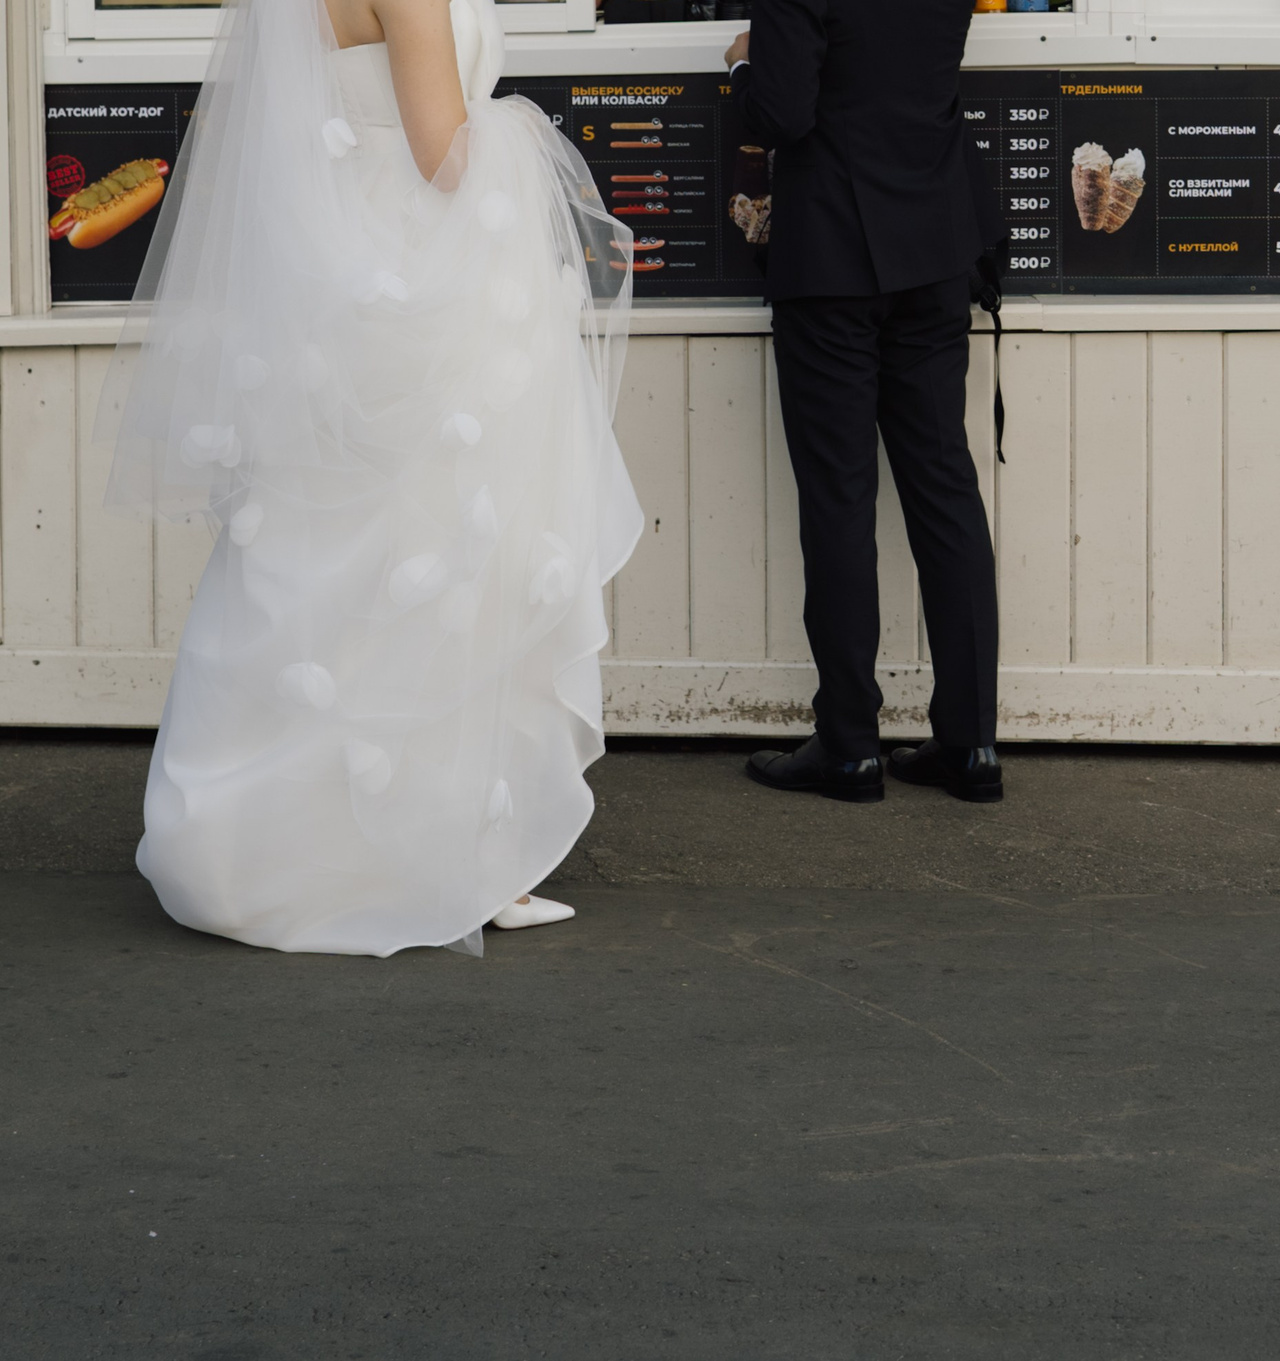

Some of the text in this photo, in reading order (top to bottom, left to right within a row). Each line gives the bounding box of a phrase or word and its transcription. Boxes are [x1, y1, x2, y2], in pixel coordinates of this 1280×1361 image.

[572, 86, 684, 96] ВЫБЕРИ СОСИСКУ
[1061, 84, 1142, 95] ТРДЕЛЬНИКИ
[572, 95, 668, 106] ИЛИ КОЛБАСКУ
[48, 105, 164, 118] ДАТСКИЙ ХОТ-ДОГ
[582, 125, 595, 141] S
[1168, 126, 1256, 135] С МОРОЖЕНЫМ
[1168, 178, 1250, 188] СО ВЗБИТЫМИ
[1168, 188, 1232, 197] СЛИВКАМИ
[1168, 241, 1238, 252] С НУТЕЛЛОЙ
